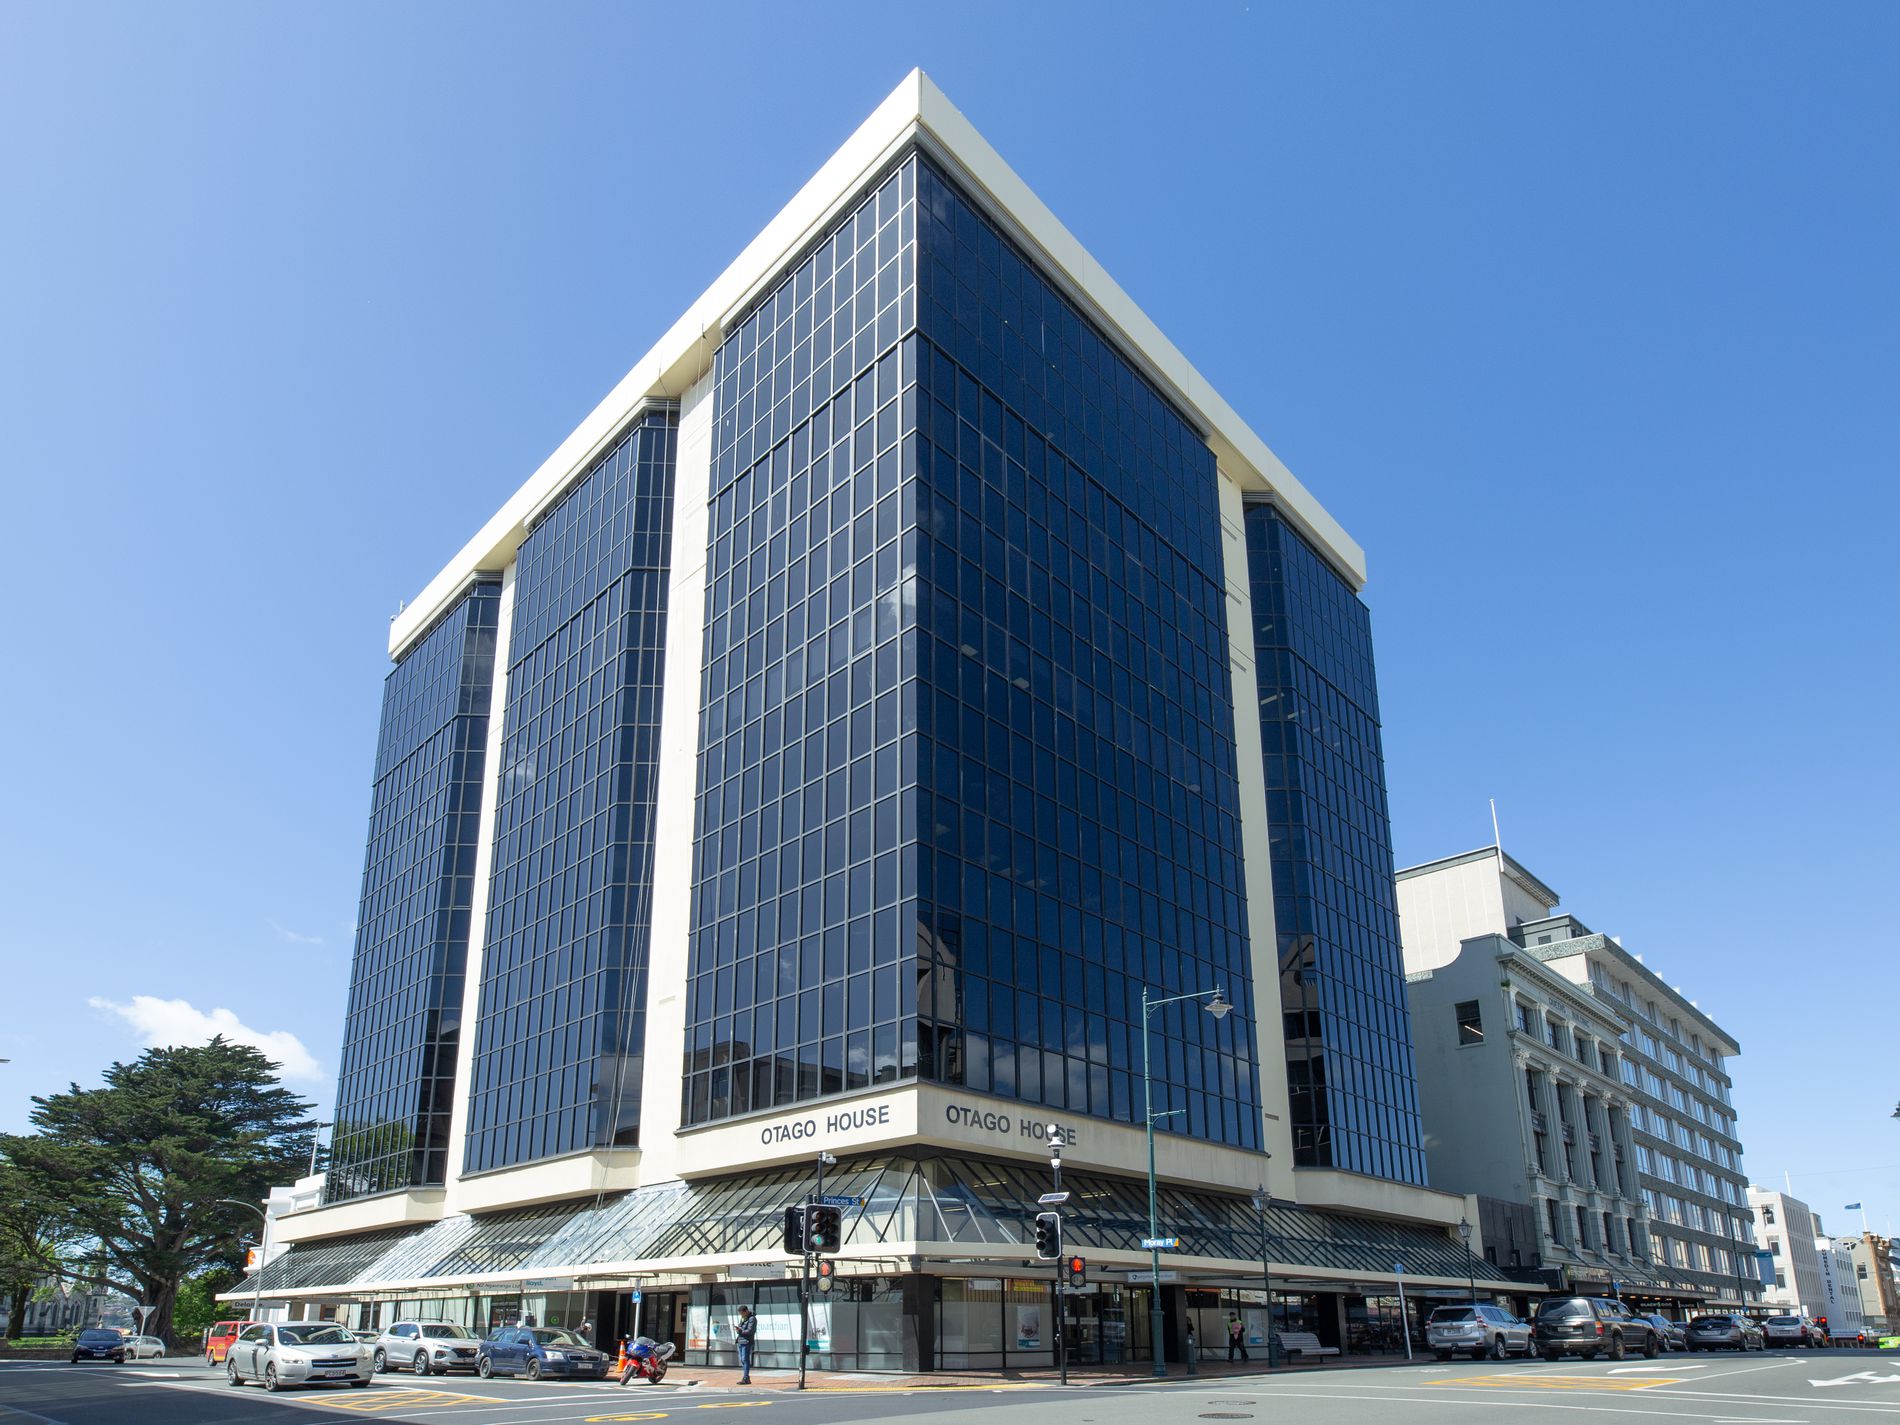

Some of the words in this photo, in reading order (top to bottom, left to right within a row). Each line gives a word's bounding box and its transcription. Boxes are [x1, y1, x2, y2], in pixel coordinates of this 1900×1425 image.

[761, 1120, 816, 1145] OTAGO
[827, 1105, 889, 1133] HOUSE
[946, 1105, 1011, 1133] OTAGO
[823, 1196, 849, 1205] Princes
[851, 1197, 860, 1206] St
[1143, 1238, 1164, 1247] Moray
[1165, 1238, 1174, 1246] Pl
